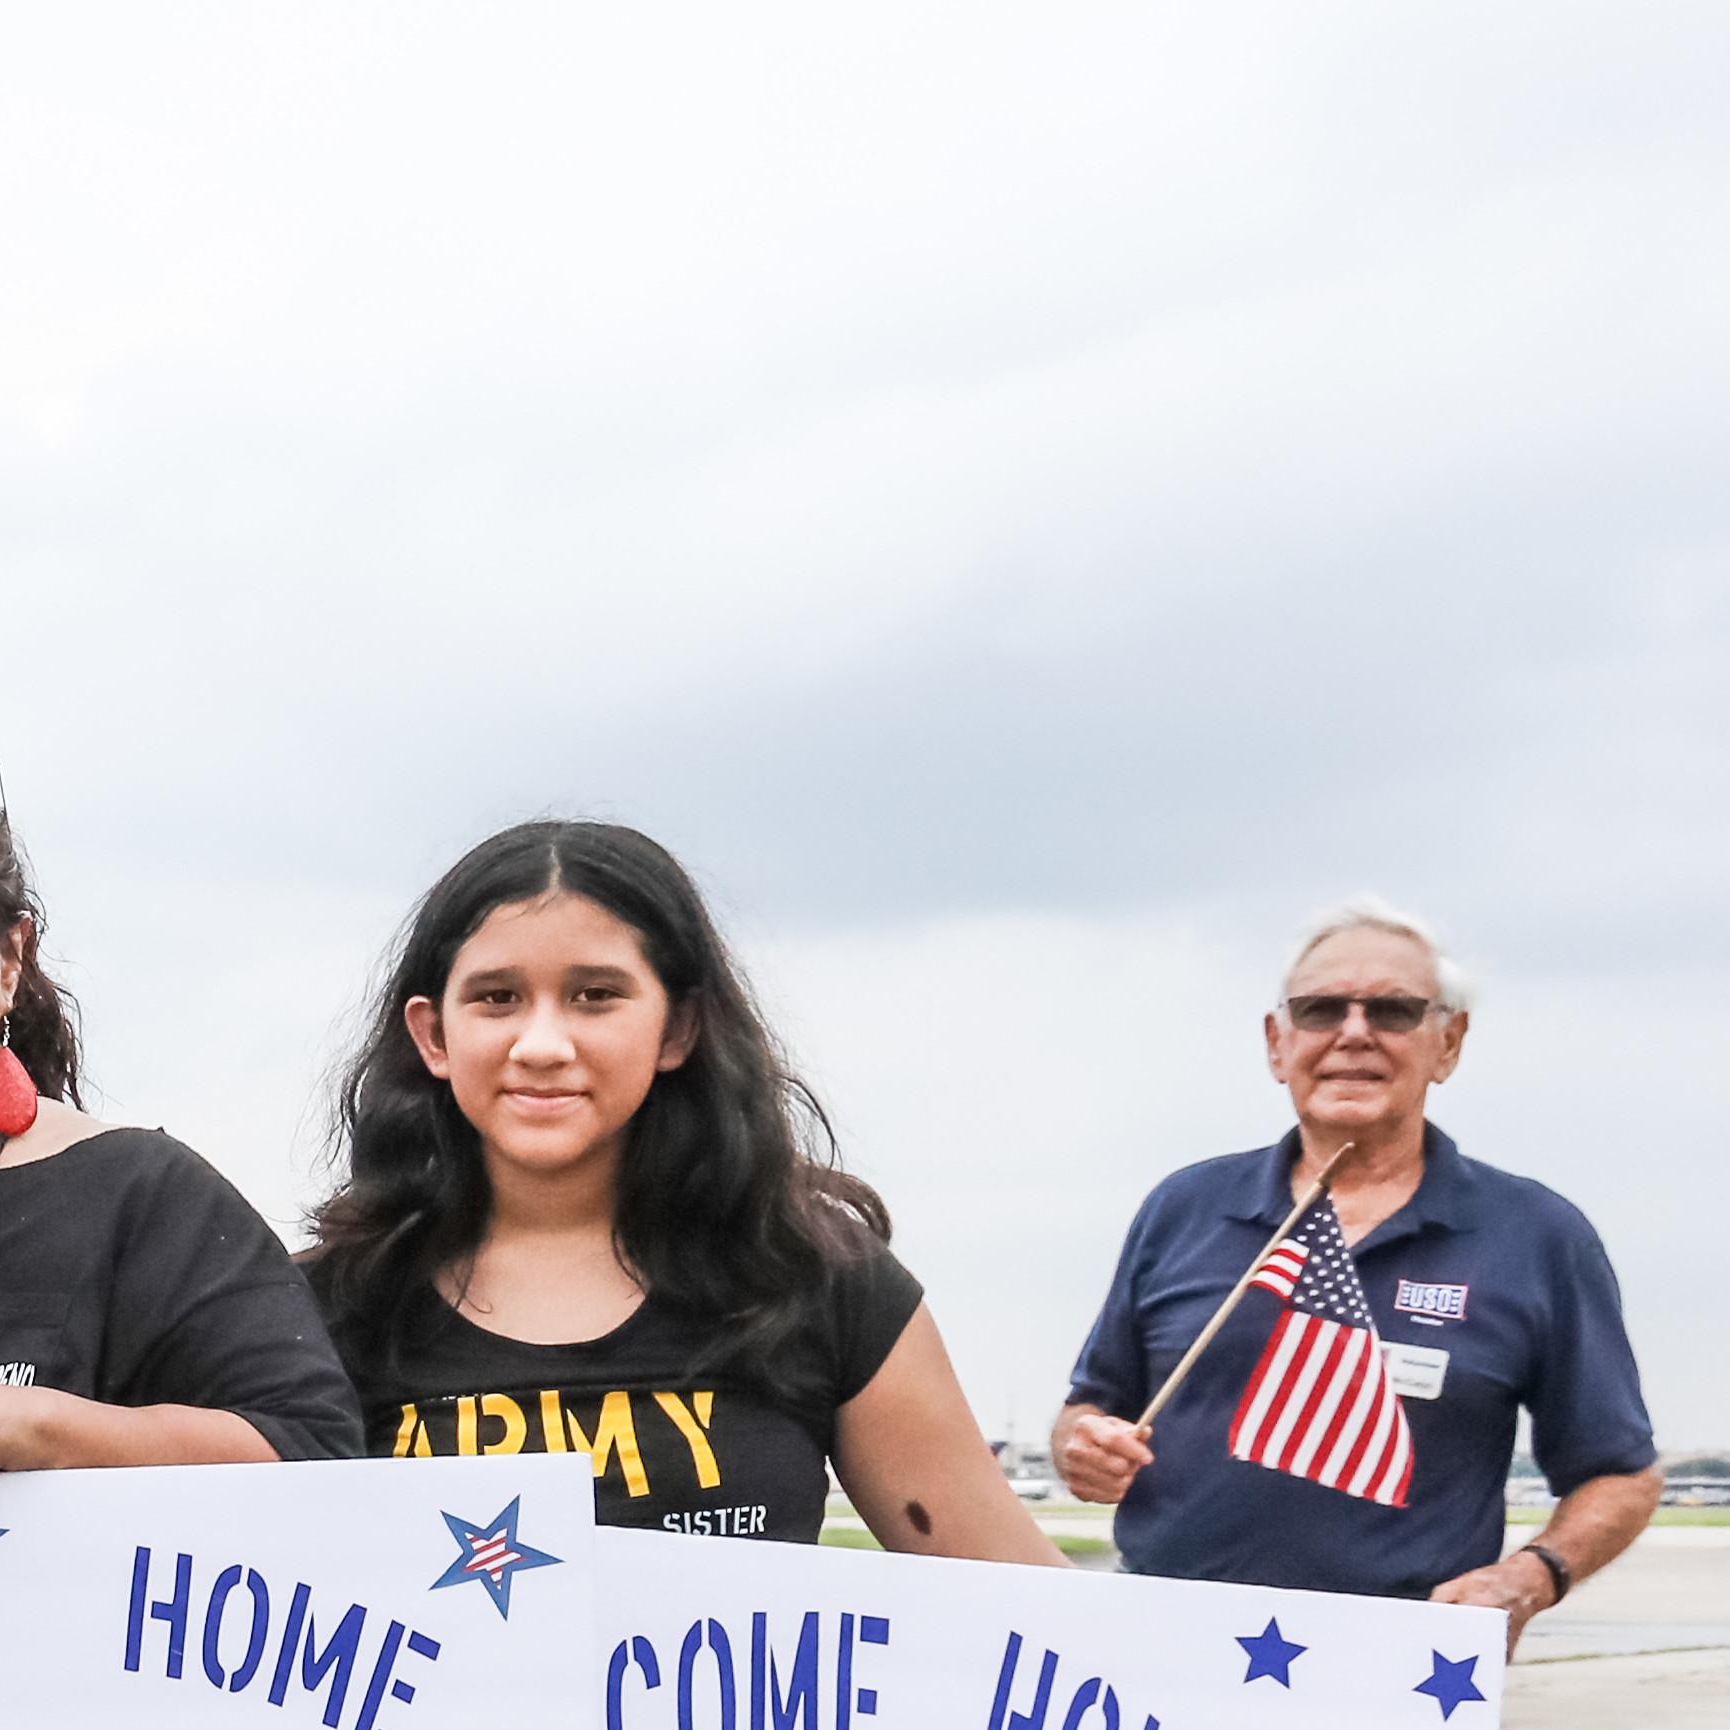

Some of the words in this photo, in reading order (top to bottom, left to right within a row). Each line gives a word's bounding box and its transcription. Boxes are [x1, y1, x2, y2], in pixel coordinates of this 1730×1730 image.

[1409, 1286, 1453, 1313] USO
[393, 1389, 721, 1497] ARMY
[662, 1504, 768, 1536] SISTER
